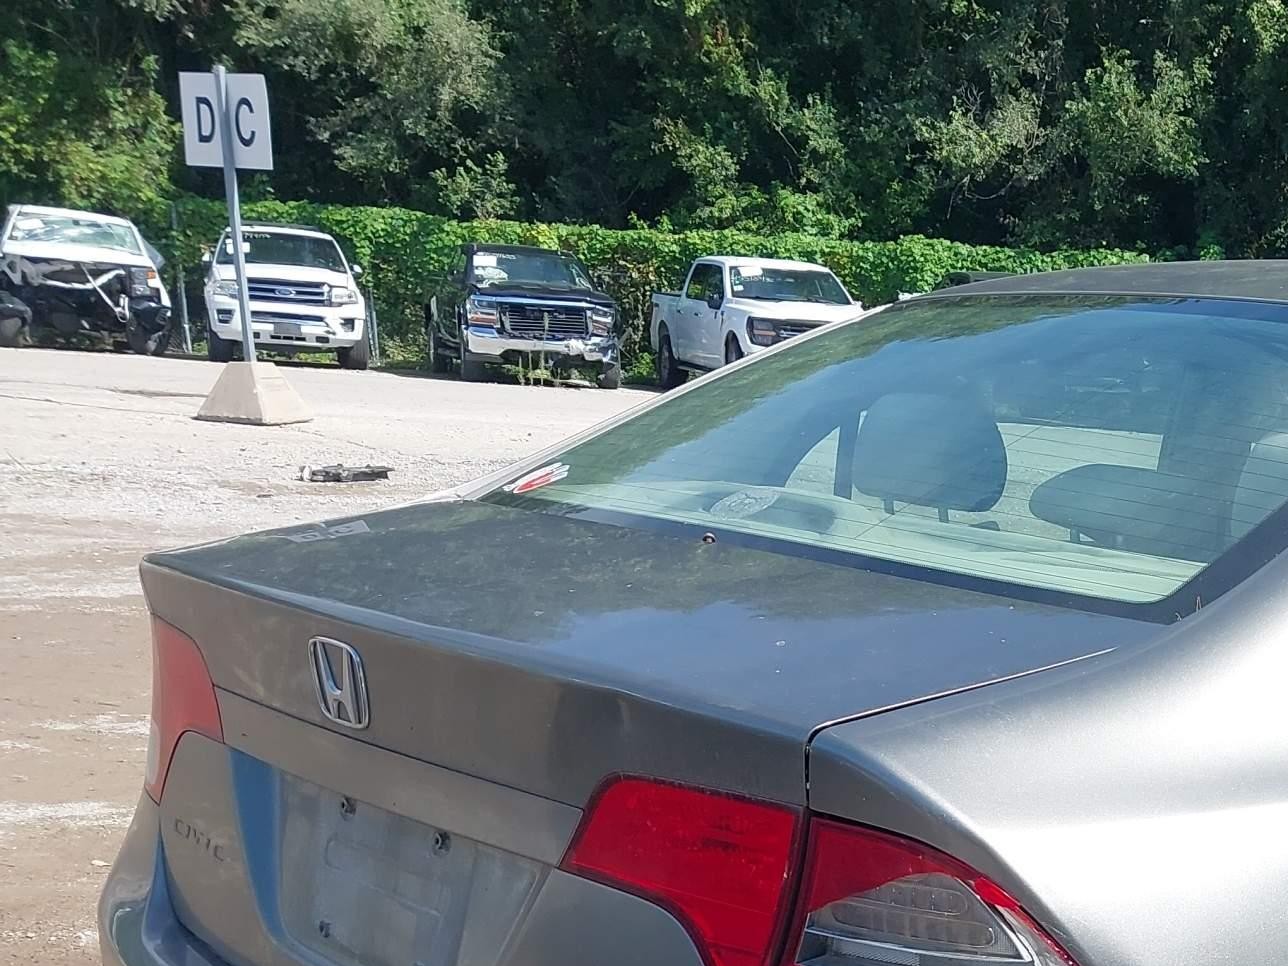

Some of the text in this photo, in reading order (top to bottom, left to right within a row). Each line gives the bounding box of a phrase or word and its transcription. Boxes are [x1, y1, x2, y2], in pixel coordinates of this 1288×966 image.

[195, 96, 256, 147] D C
[175, 818, 225, 862] CIVIC
